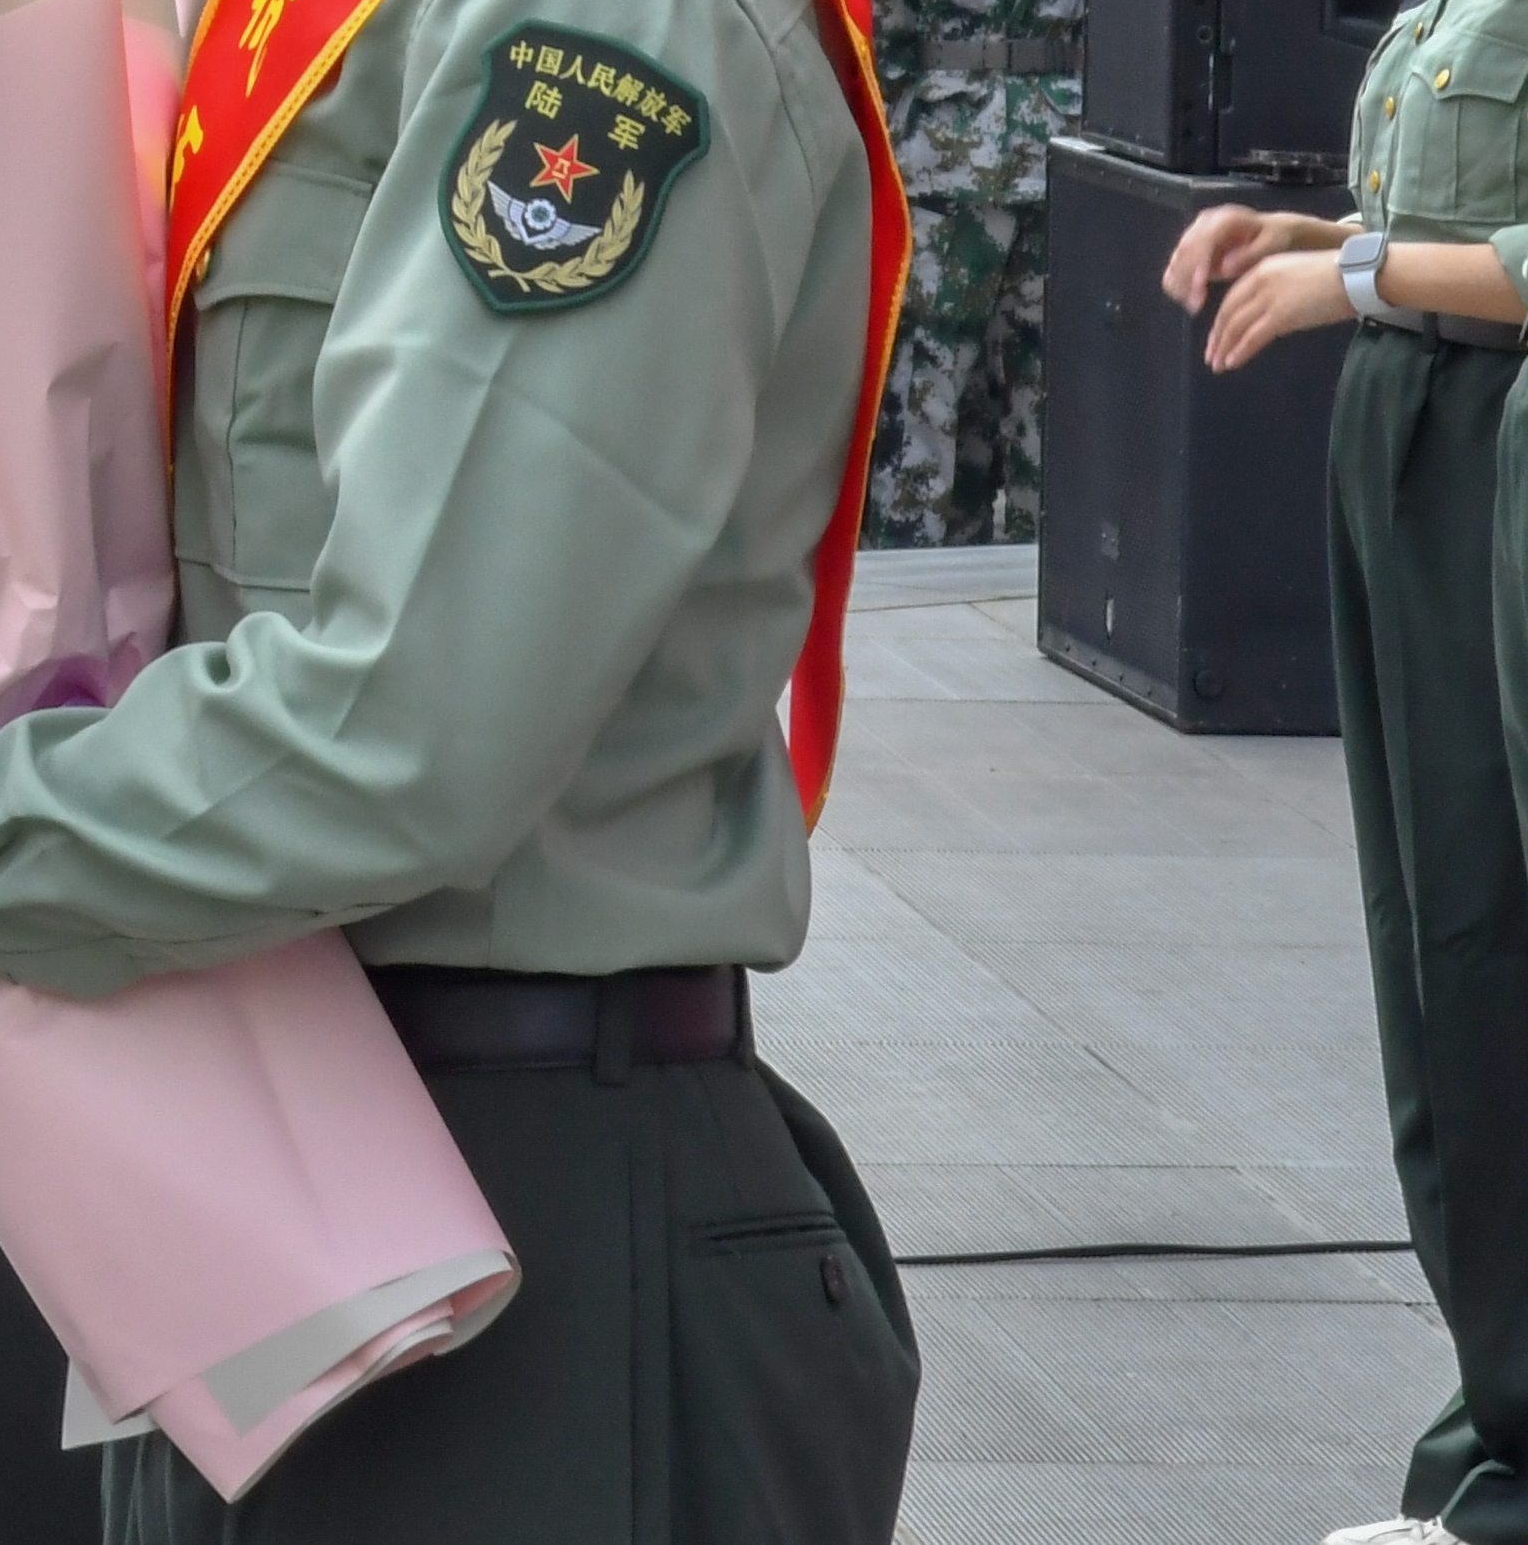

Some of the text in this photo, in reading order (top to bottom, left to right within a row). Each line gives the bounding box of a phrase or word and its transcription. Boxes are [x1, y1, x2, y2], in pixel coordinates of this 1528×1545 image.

[509, 40, 692, 137] 中国人民解放军
[524, 80, 646, 151] 陆军
